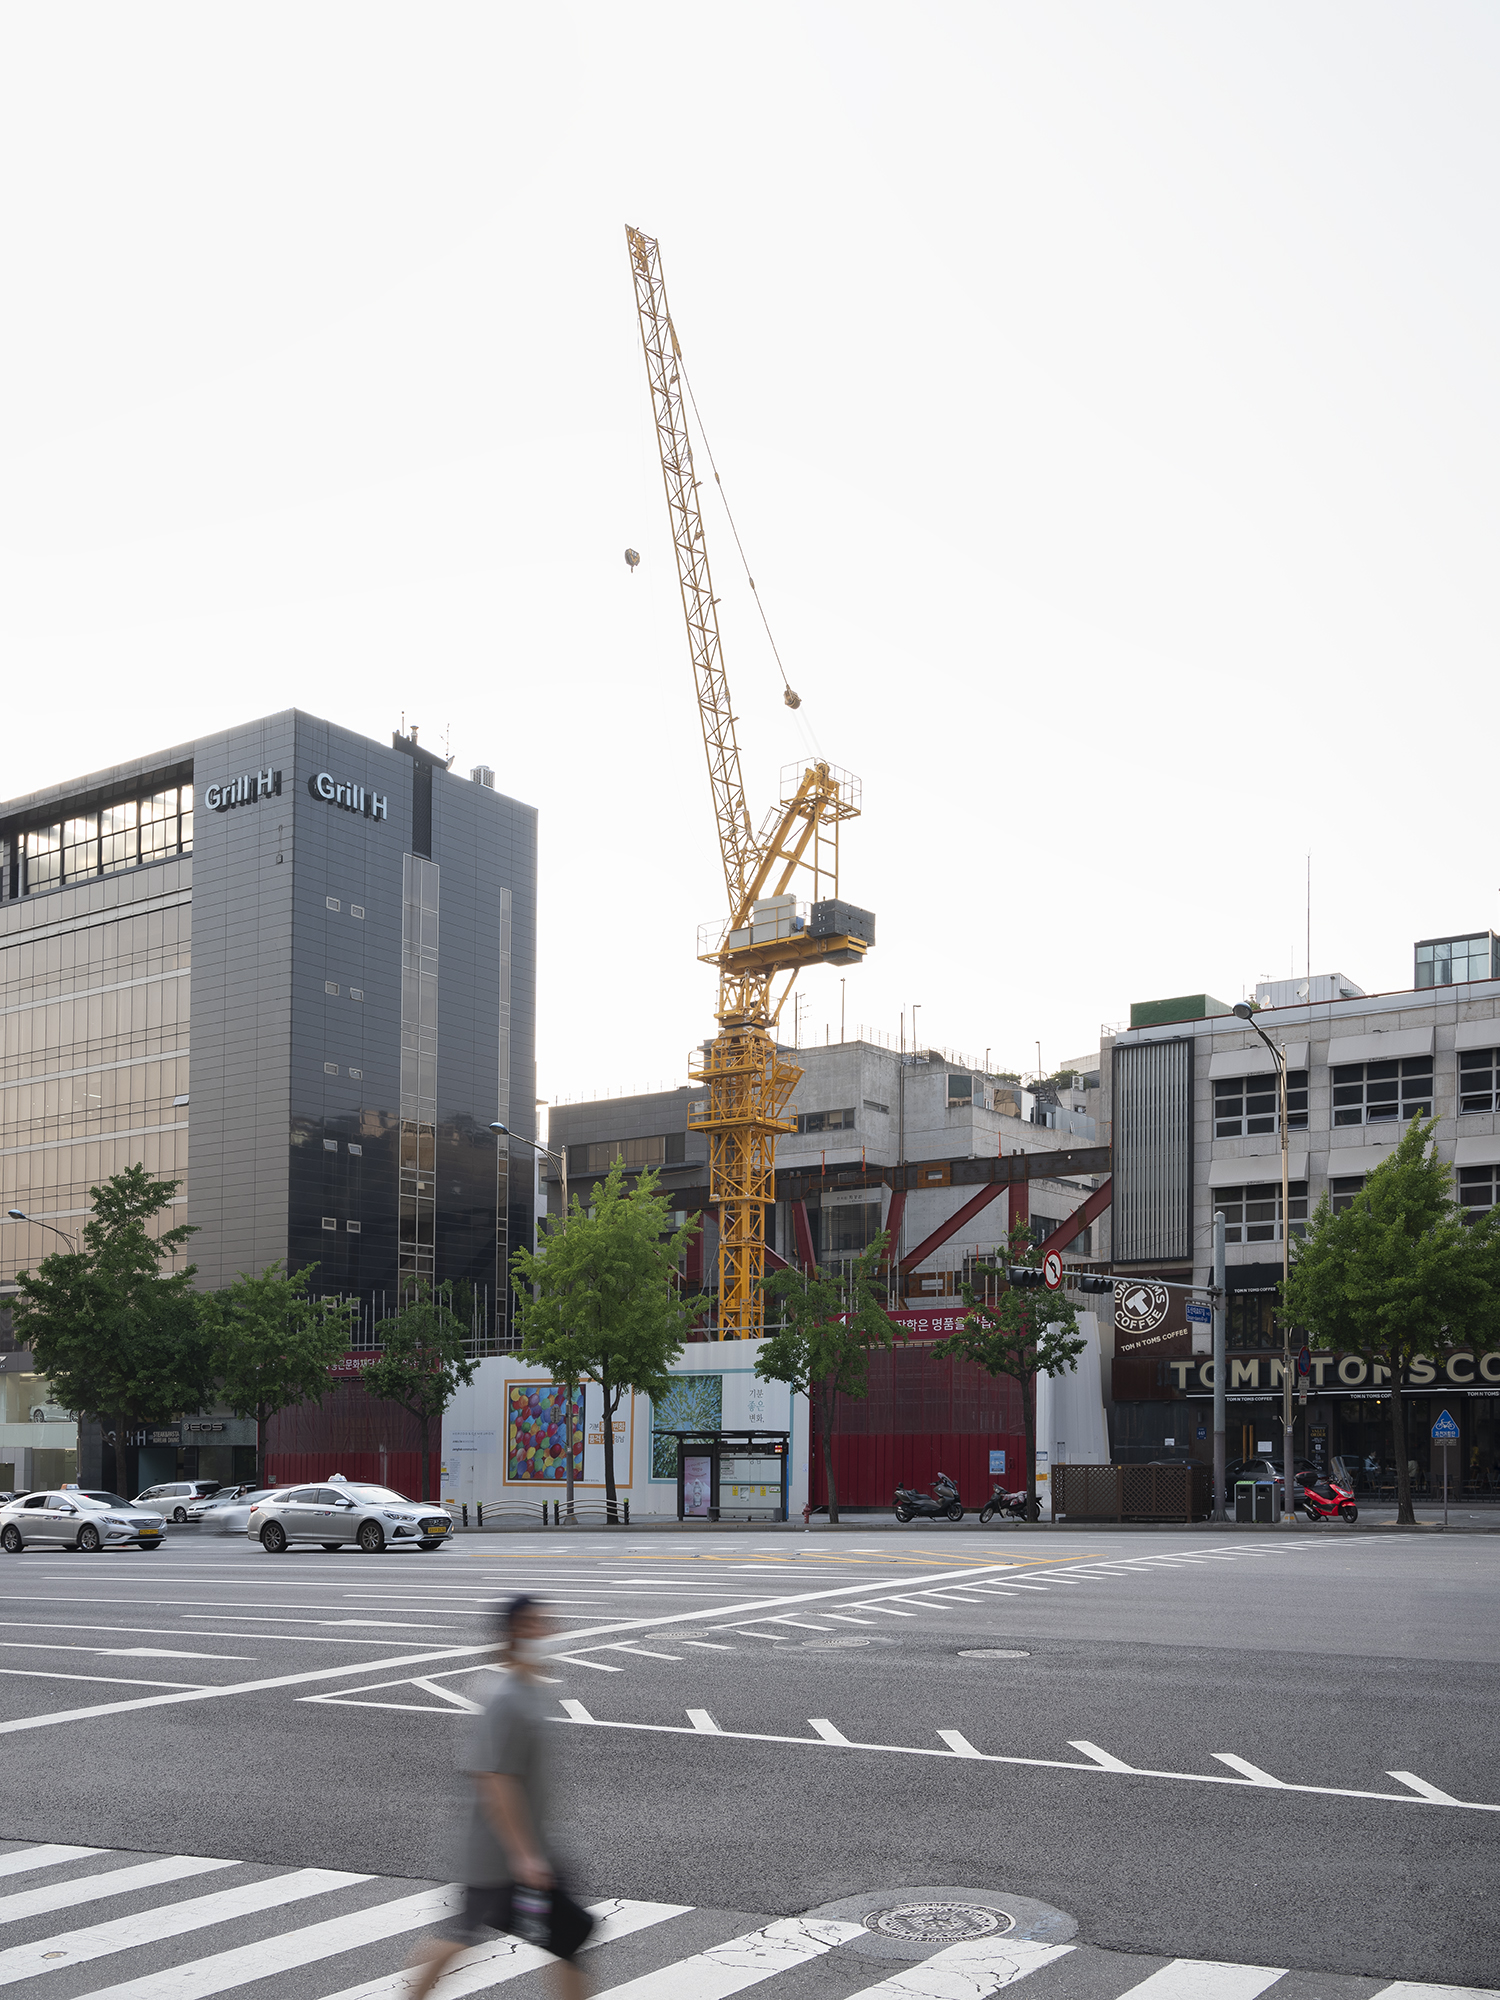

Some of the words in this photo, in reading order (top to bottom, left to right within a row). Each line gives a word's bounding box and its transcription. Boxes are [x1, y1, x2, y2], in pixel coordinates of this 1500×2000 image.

[204, 774, 251, 810] Grill
[257, 767, 274, 796] H
[316, 772, 365, 812] Grill
[372, 791, 388, 821] H
[932, 1317, 965, 1332] 명품을
[1115, 1309, 1162, 1330] COFFEE
[1121, 1341, 1136, 1352] TOM
[1142, 1335, 1161, 1346] TOMS
[1162, 1328, 1189, 1341] COFFEE
[1169, 1358, 1260, 1390] TOM
[749, 1388, 764, 1399] 기분
[747, 1400, 765, 1412] 좋은
[589, 1423, 599, 1431] 기분
